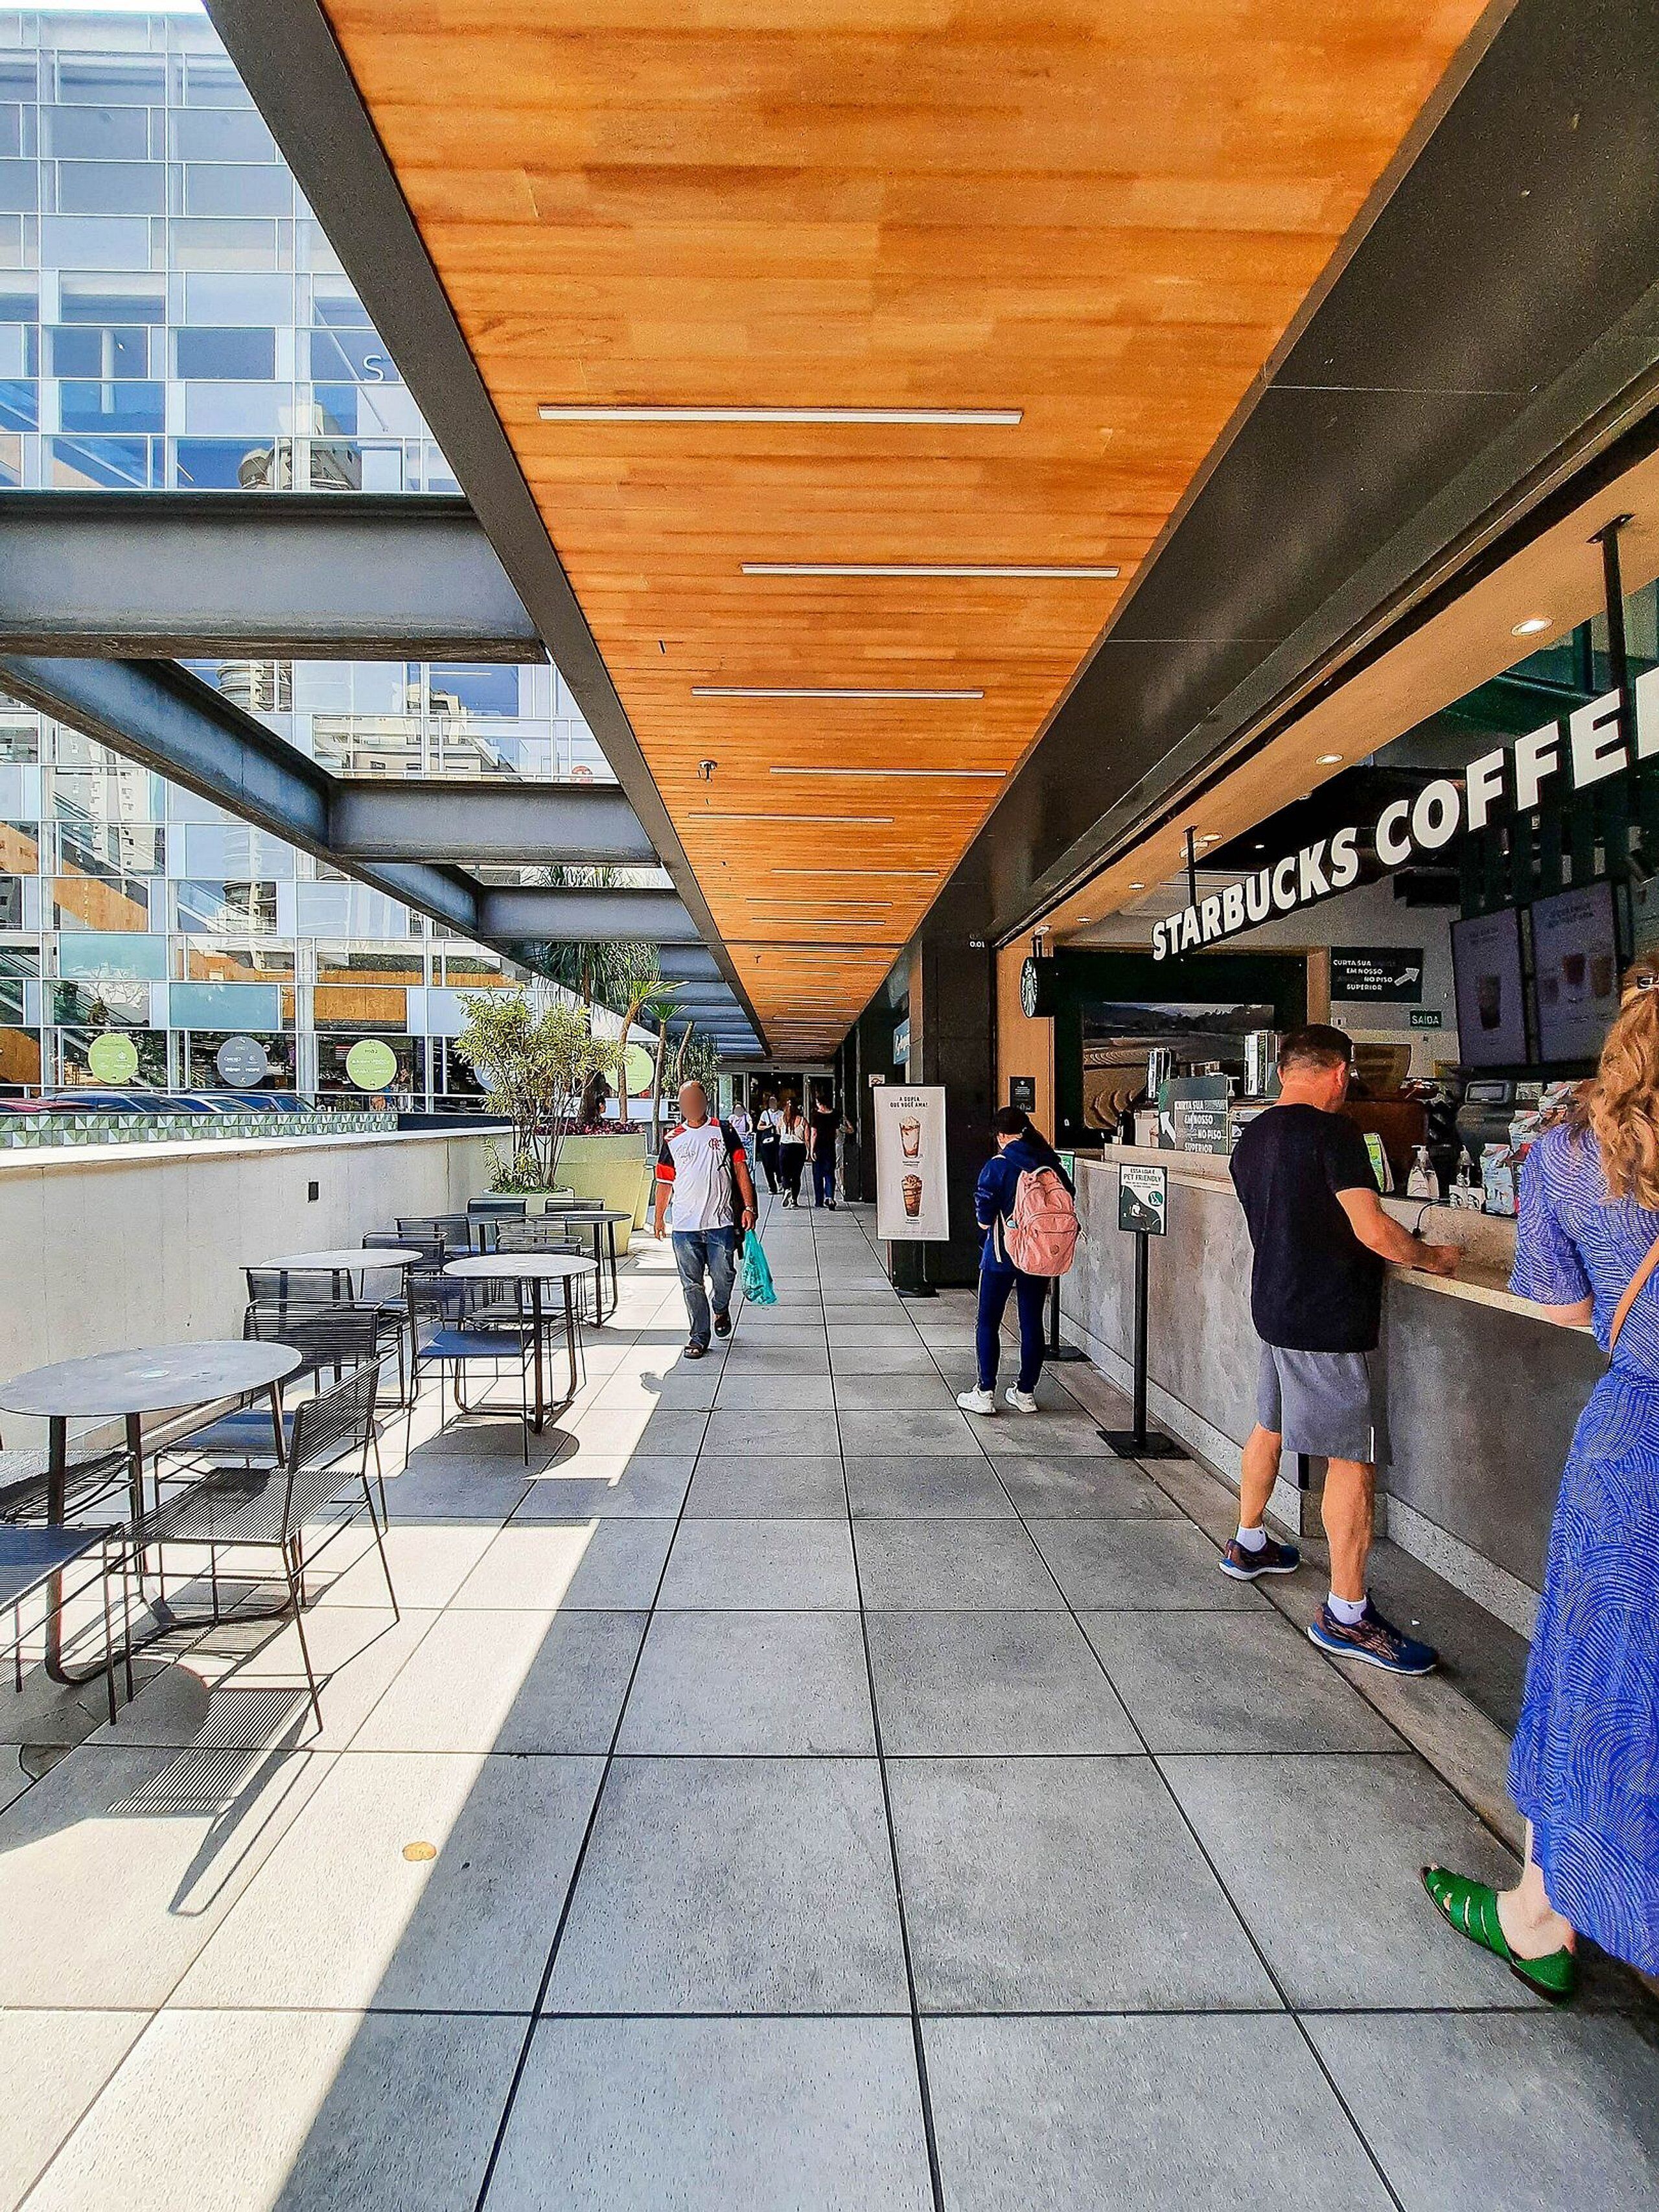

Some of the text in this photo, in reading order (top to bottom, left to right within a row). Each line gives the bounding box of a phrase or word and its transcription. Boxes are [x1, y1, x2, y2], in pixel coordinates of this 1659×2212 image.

[1152, 828, 1359, 960] STARBUCKS
[1192, 1100, 1204, 1110] SUA
[1198, 1129, 1207, 1139] NO
[1207, 1130, 1222, 1140] PISO
[1185, 1143, 1212, 1154] SUPERIOR
